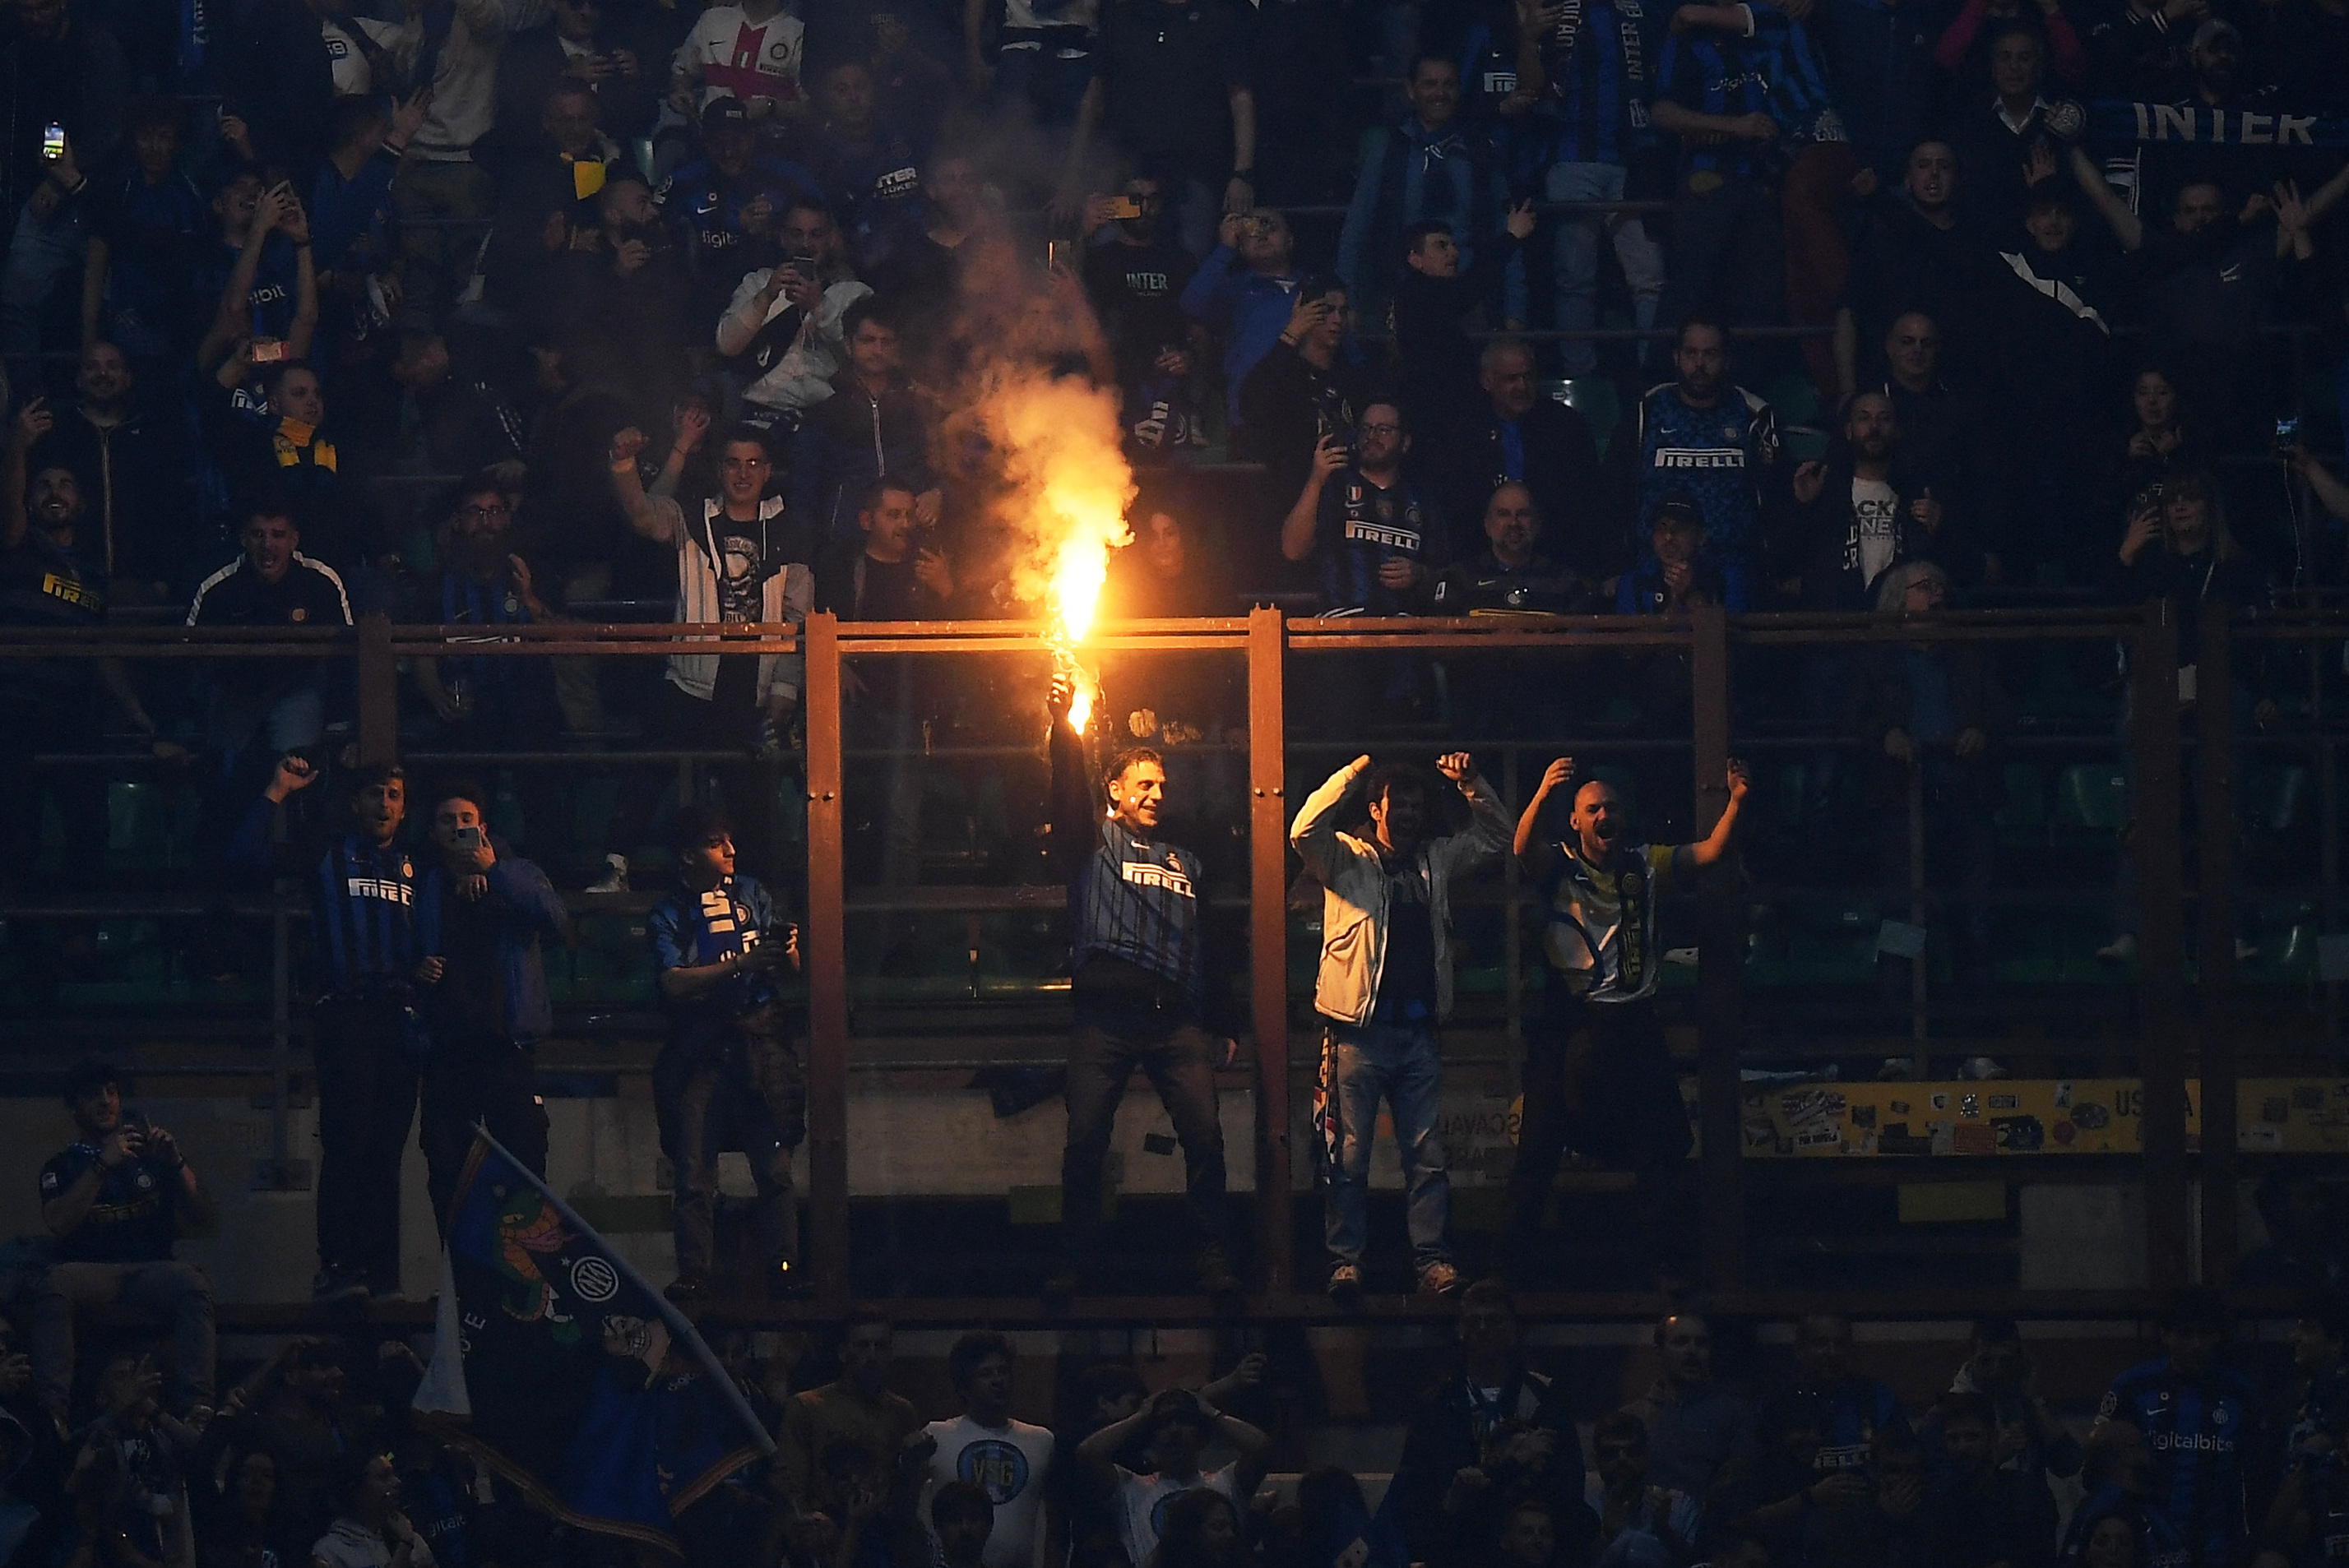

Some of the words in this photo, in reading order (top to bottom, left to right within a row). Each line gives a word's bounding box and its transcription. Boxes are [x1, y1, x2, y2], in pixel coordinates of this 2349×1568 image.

[1126, 272, 1169, 290] INTER
[1654, 446, 1745, 468] PIRELLI
[1857, 499, 1896, 516] CK
[1122, 860, 1196, 899] PIRELL
[348, 877, 413, 906] PIREL
